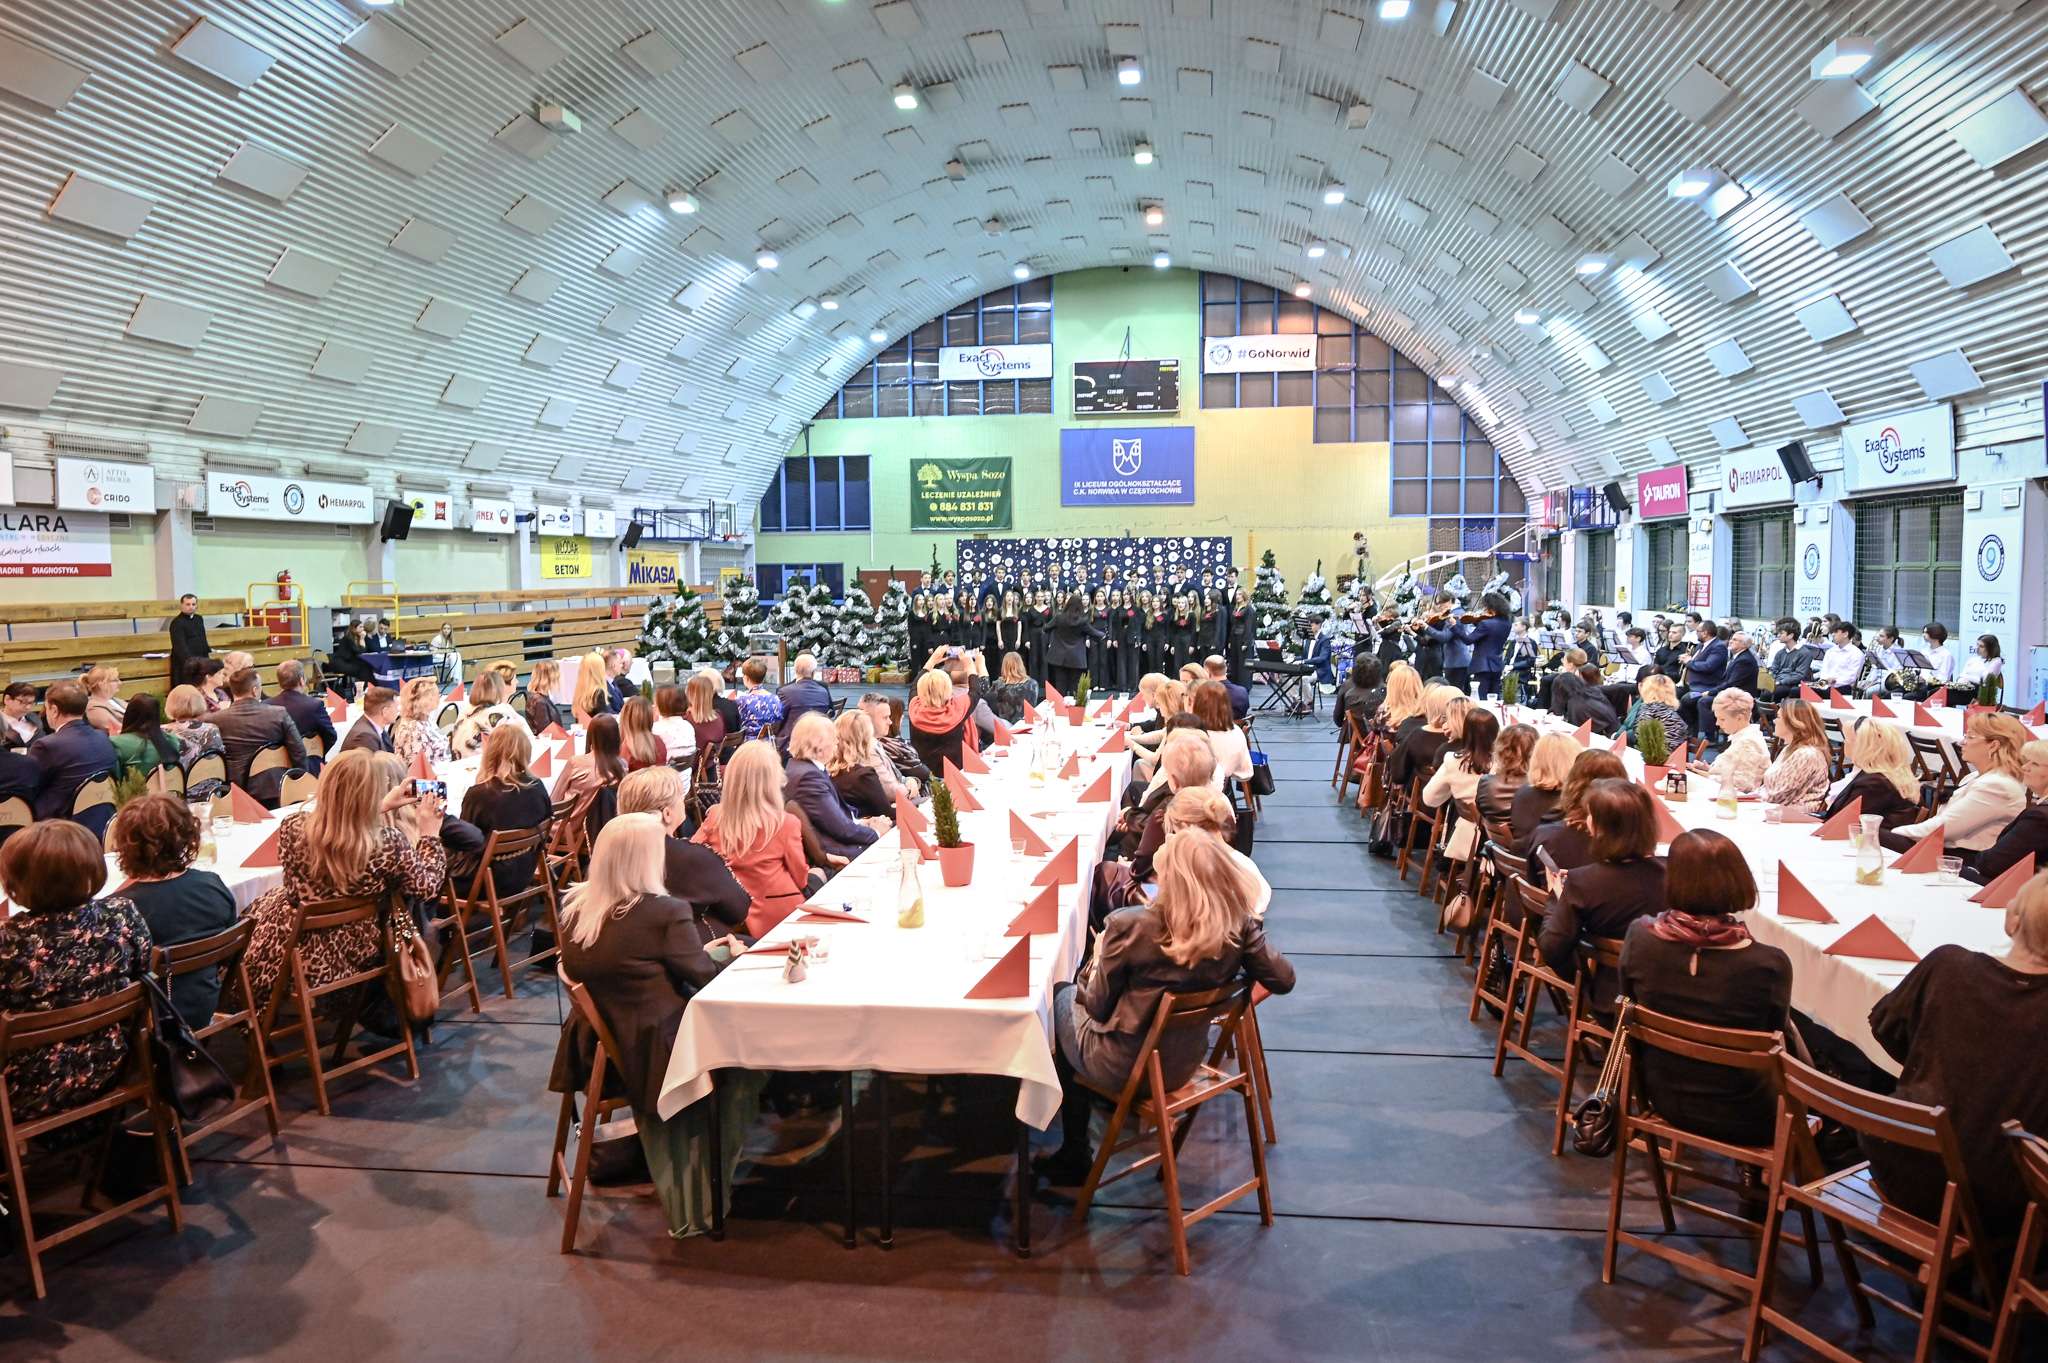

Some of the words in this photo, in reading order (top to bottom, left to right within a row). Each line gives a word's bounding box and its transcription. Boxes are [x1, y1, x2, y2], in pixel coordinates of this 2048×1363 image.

[959, 353, 990, 363] Exact
[1237, 347, 1311, 359] #GoNorwid
[982, 361, 1031, 372] Systems
[1865, 438, 1889, 453] Exact
[1883, 446, 1926, 465] Systems
[946, 470, 978, 482] Wyspa
[981, 469, 1006, 480] Sozo
[1739, 466, 1783, 486] HEMARPOL
[219, 483, 242, 494] Exact
[1082, 480, 1108, 488] LICEUM
[921, 491, 956, 499] LECZENIE
[1652, 482, 1681, 501] TAURON
[236, 492, 269, 504] Systems
[329, 498, 367, 509] HEMARPOL
[0, 512, 68, 532] LARA
[32, 566, 79, 575] DIAGNOSTYKA
[555, 565, 579, 575] BETON
